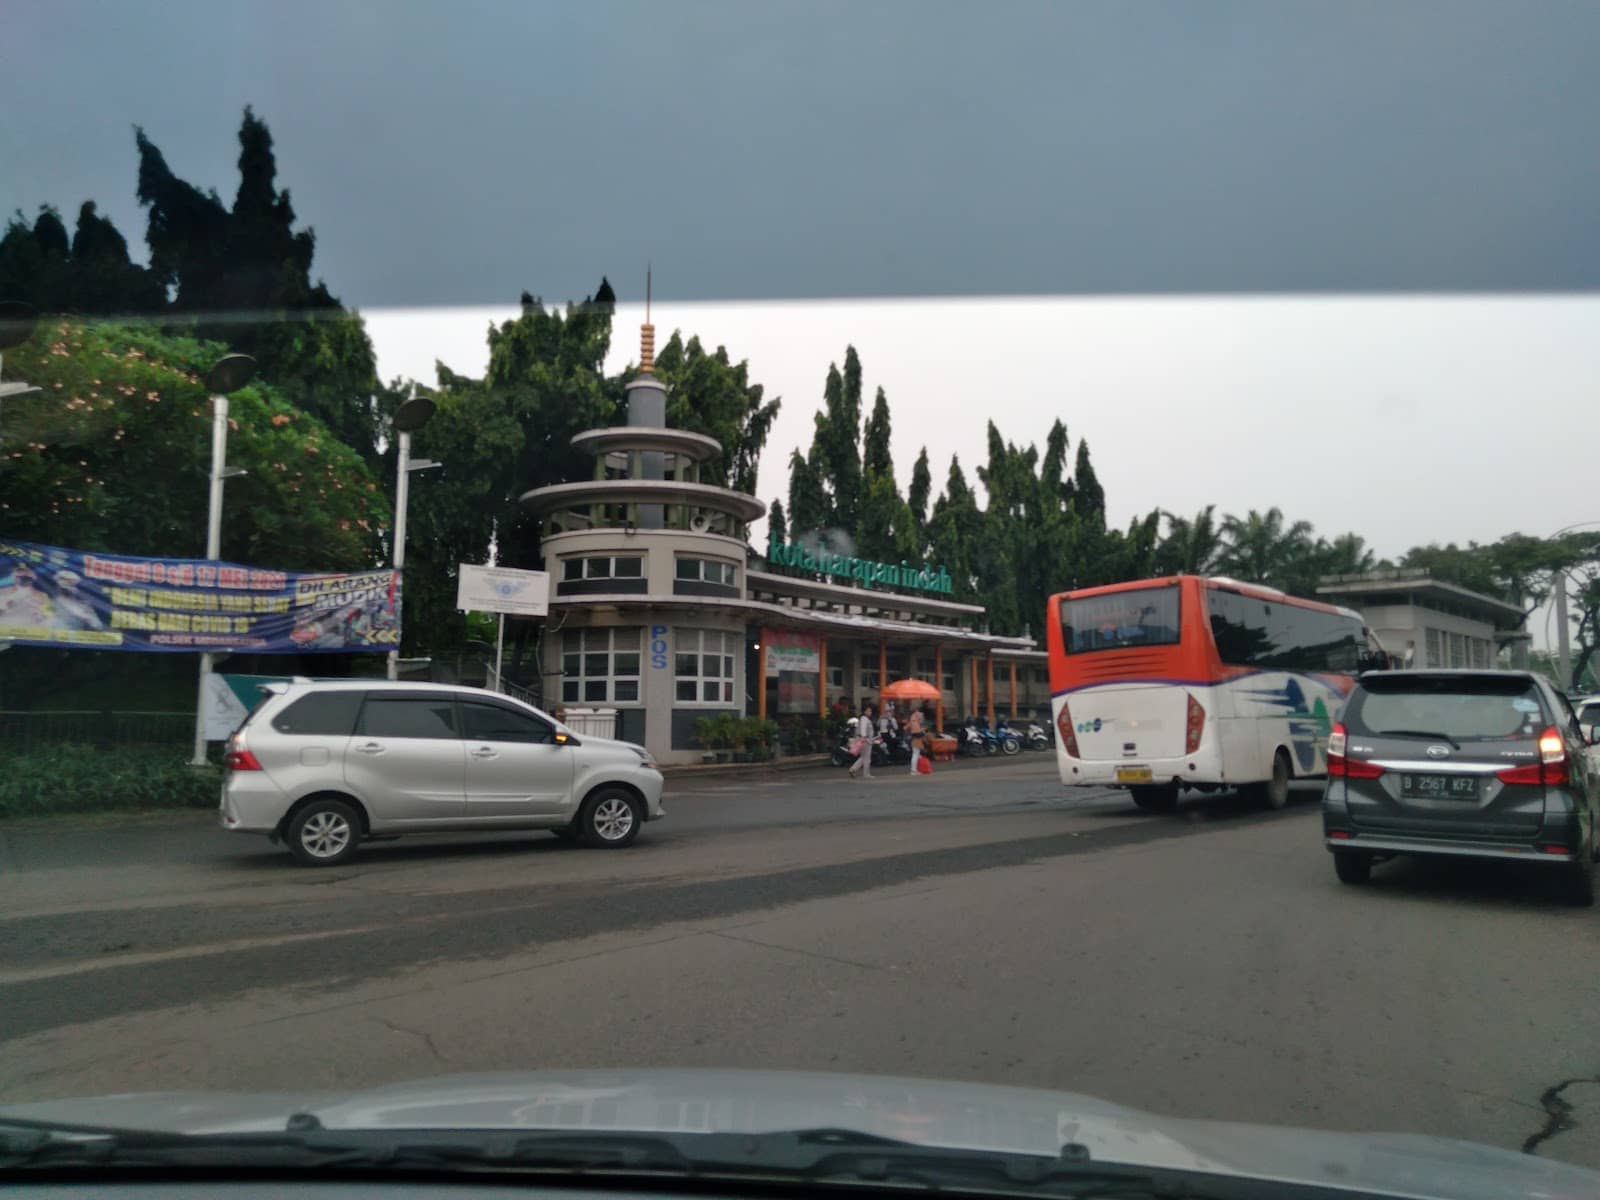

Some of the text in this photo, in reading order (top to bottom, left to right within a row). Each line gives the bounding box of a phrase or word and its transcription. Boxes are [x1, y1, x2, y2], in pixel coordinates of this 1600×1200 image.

[299, 574, 391, 594] DILARANG
[769, 530, 953, 593] kota harapan indah
[651, 624, 667, 669] POS
